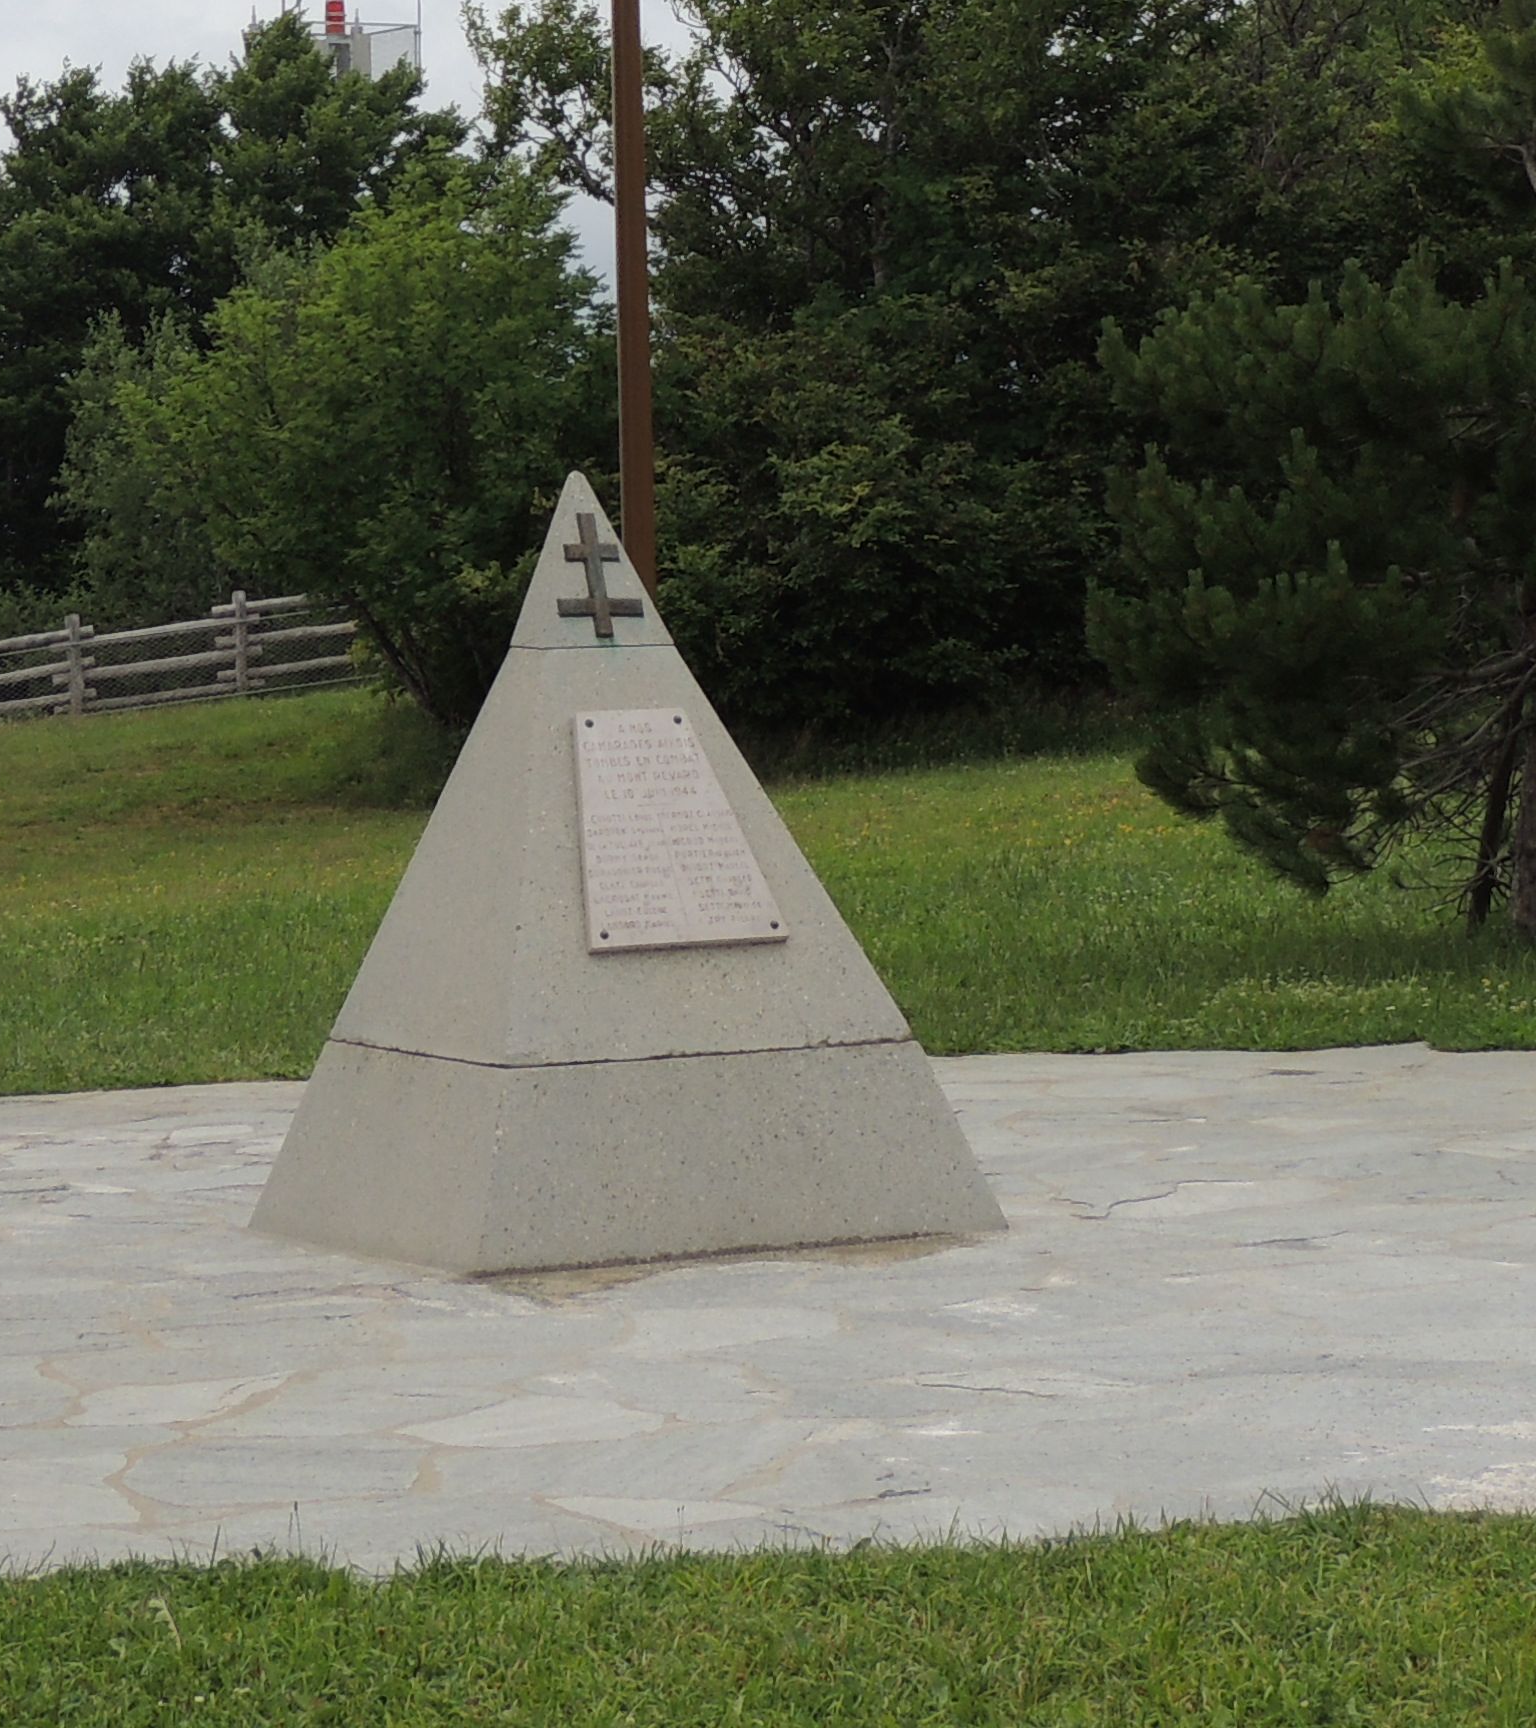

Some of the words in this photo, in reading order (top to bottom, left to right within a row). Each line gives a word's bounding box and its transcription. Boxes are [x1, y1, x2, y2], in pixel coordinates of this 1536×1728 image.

[582, 738, 652, 752] CAMARADES
[635, 755, 651, 766] EN
[655, 751, 700, 765] COMBAT
[616, 770, 648, 783] MONT
[652, 768, 701, 782] REVARD
[603, 788, 618, 800] LE
[671, 785, 698, 797] 1944
